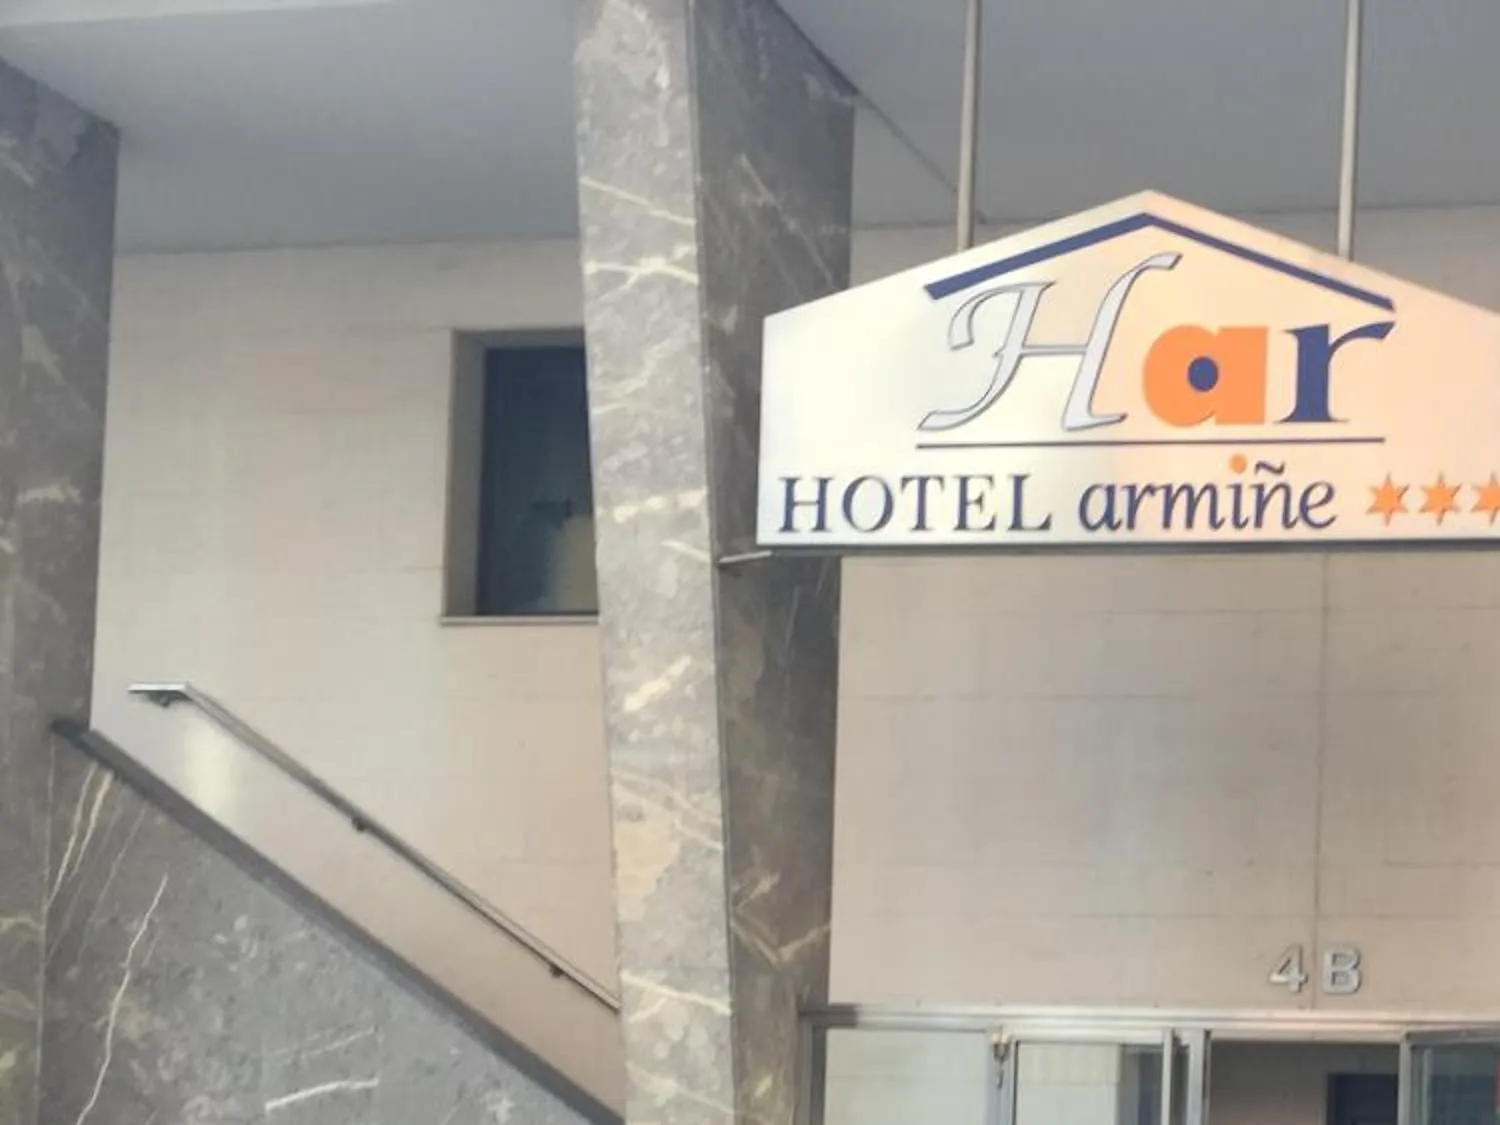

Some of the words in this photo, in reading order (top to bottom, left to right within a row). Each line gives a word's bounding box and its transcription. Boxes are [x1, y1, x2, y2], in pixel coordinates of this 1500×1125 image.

[917, 252, 1396, 431] Har
[778, 473, 1053, 534] HOTEL
[1077, 454, 1338, 532] armiñe
